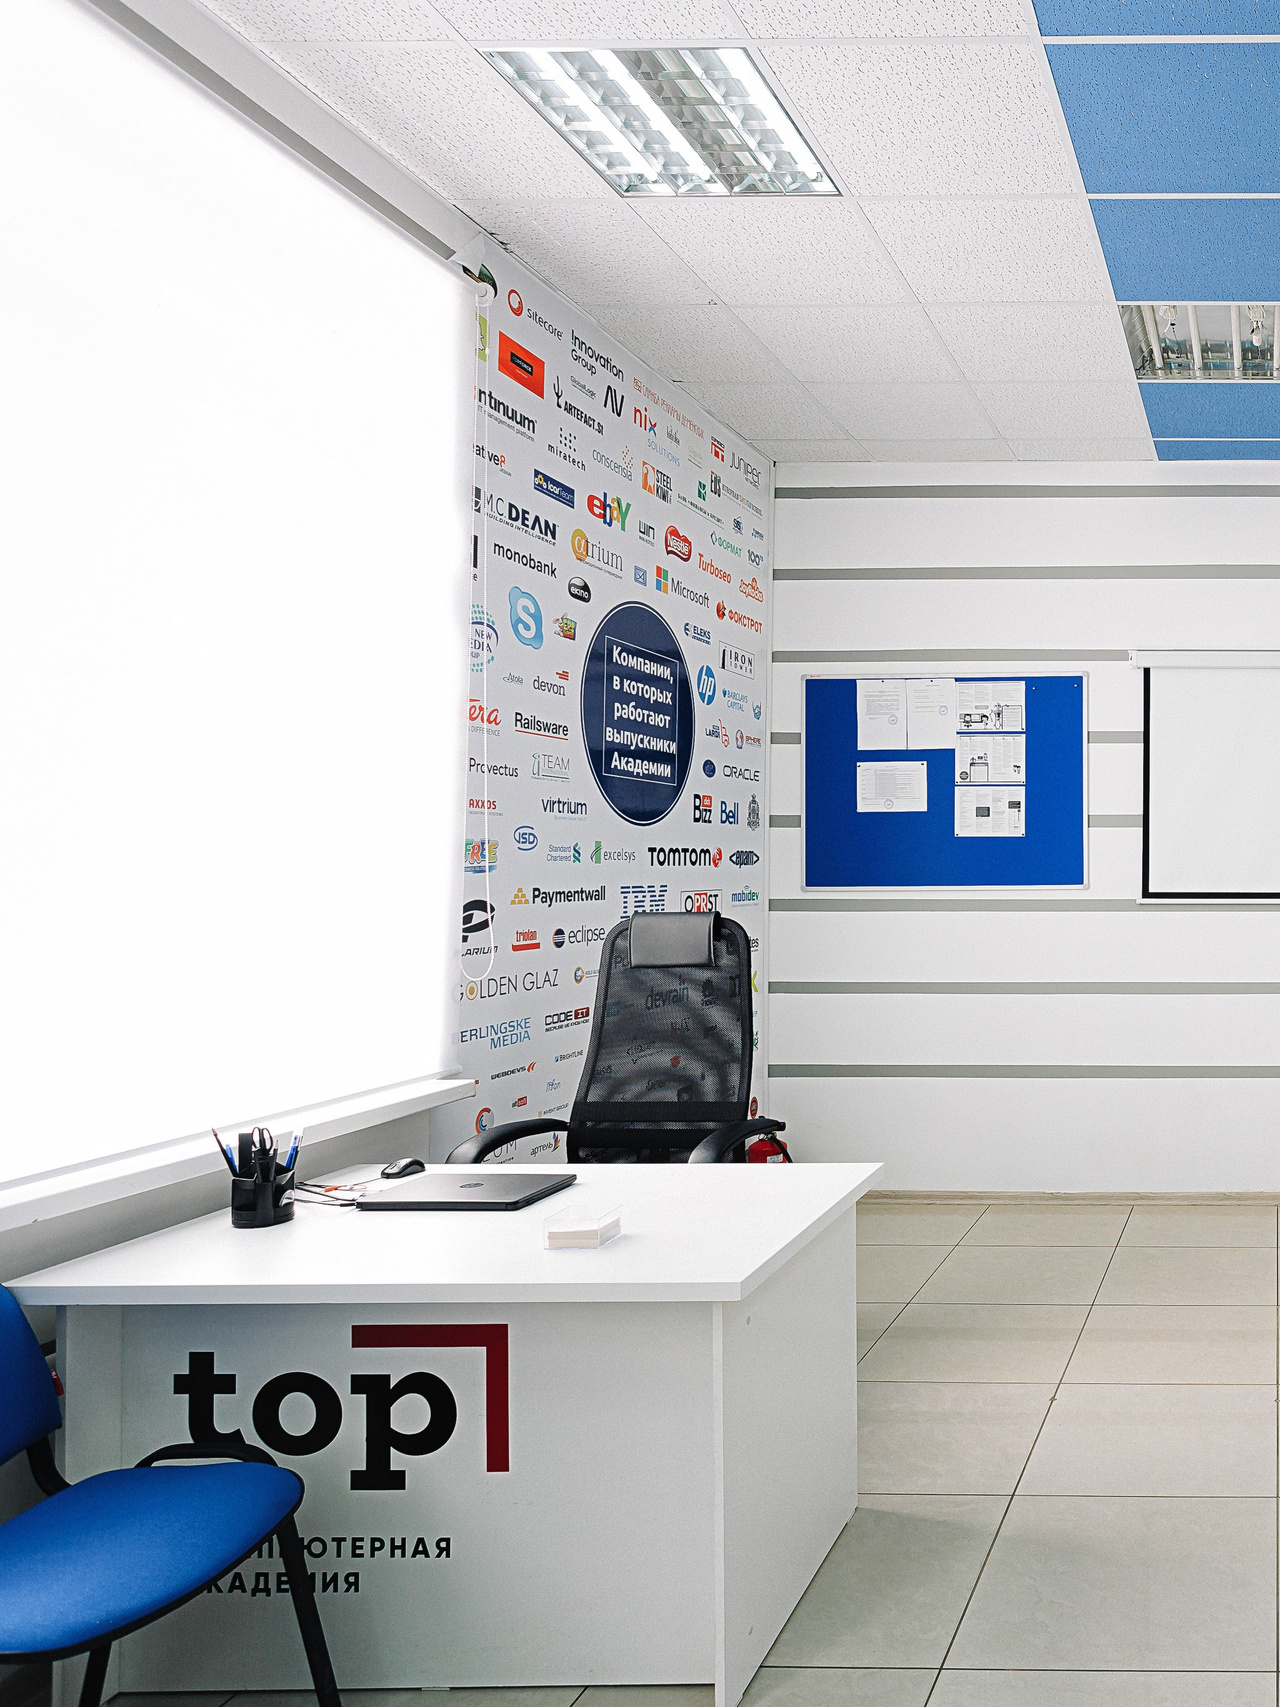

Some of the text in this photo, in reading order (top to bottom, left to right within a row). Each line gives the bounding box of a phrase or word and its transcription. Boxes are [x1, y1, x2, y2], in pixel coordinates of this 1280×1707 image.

[527, 308, 562, 341] sitecore
[571, 349, 597, 376] Group
[633, 406, 657, 438] nix
[548, 444, 586, 472] miratech
[592, 449, 632, 482] conscensia
[648, 438, 680, 468] SOLUTIONS
[655, 483, 669, 504] KIWI
[656, 470, 673, 492] STEEL
[508, 502, 557, 541] DEAN
[493, 542, 557, 579] monobank
[698, 552, 732, 584] Turboseo
[671, 577, 710, 609] Microsoft
[693, 625, 711, 640] ELEKS
[728, 608, 763, 634] ФОКСТРОТ
[612, 645, 674, 684] Компании,
[730, 649, 753, 668] IRON
[533, 676, 566, 697] devon
[613, 676, 673, 705] в которых
[515, 711, 569, 736] Railsware
[614, 702, 671, 729] работают
[606, 726, 677, 755] выпускники
[541, 753, 570, 772] TEAM
[611, 752, 671, 778] Академии
[722, 765, 761, 782] ORACLE
[541, 796, 587, 816] virtrium
[720, 800, 739, 825] Bell
[519, 832, 536, 845] ISD
[548, 844, 571, 853] Standard
[547, 853, 571, 862] Chartered
[603, 848, 636, 863] excelsys
[532, 885, 606, 908] Paymentwall
[620, 885, 667, 919] IBM
[731, 889, 760, 903] mobidev
[516, 929, 538, 943] triolan
[568, 925, 605, 946] eclipse
[522, 969, 559, 992] GLAZ
[460, 1017, 531, 1043] ERLINGSKE
[545, 1010, 573, 1026] CODE
[490, 1030, 531, 1050] MEDIA
[559, 1049, 584, 1062] BRIGHTLINE
[173, 1351, 458, 1490] top
